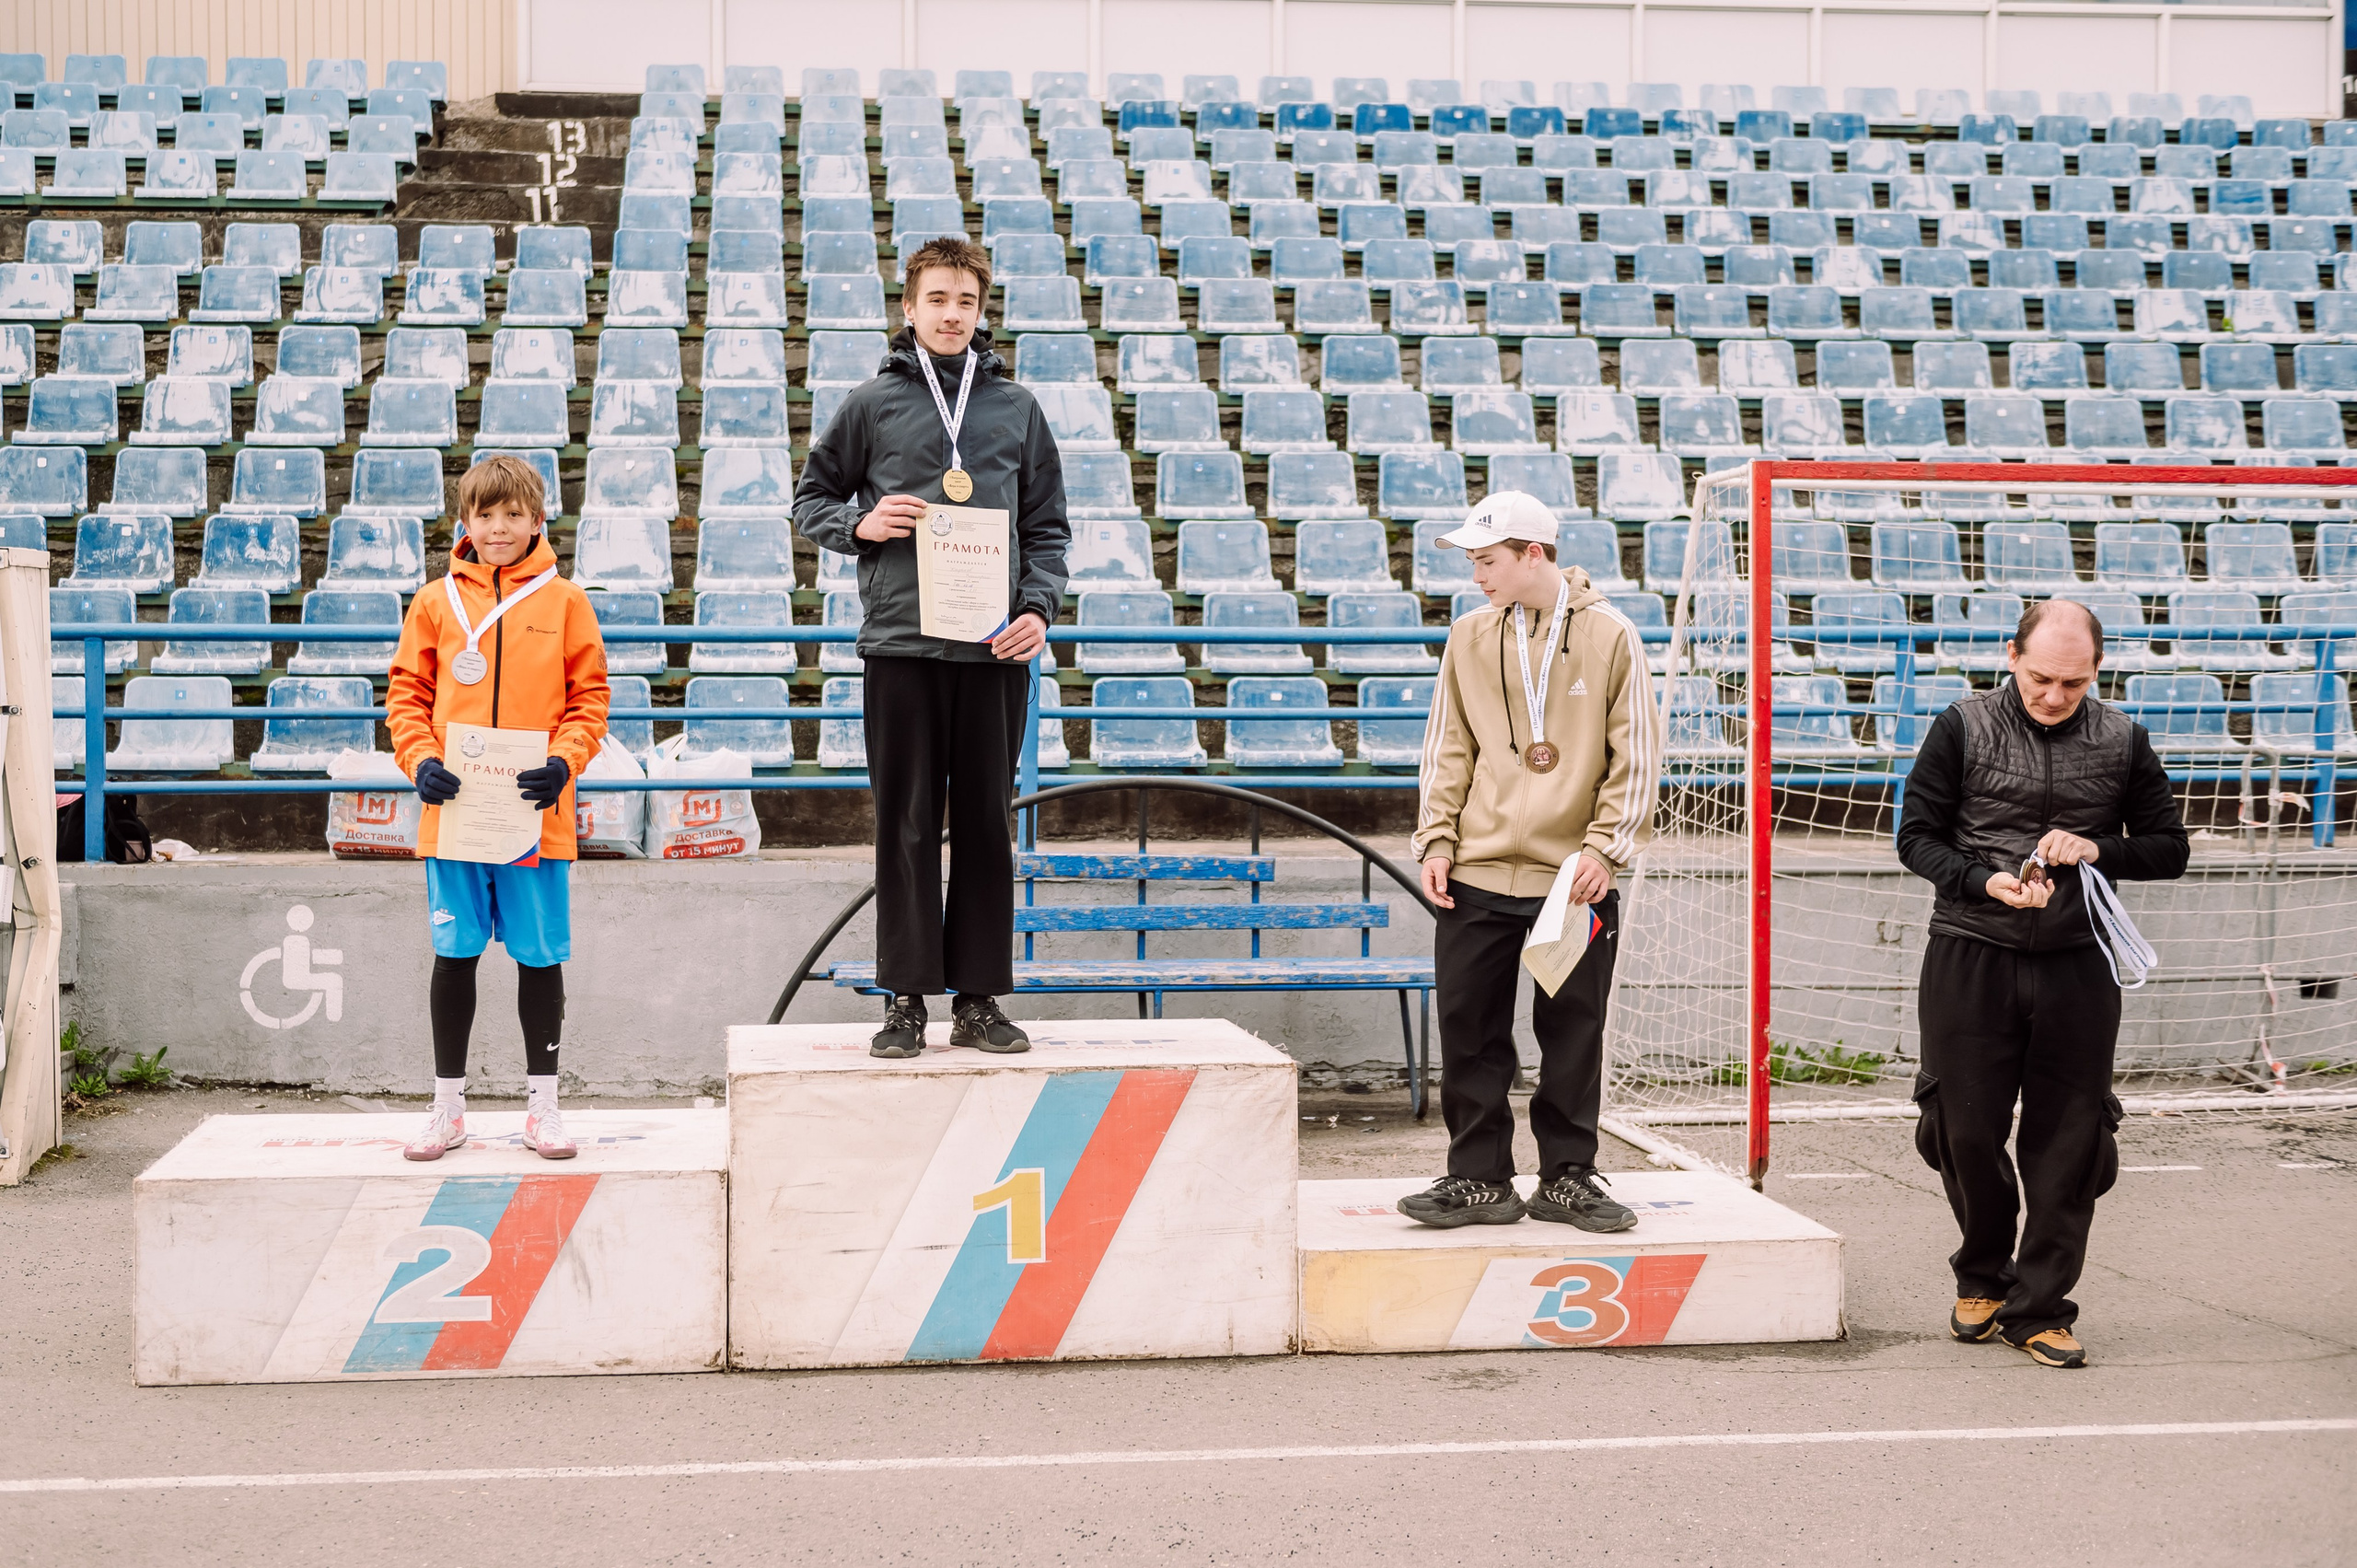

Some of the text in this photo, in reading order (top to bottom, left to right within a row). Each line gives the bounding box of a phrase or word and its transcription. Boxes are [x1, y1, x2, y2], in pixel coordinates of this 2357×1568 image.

[547, 121, 586, 154] 13
[536, 153, 578, 188] 12
[525, 186, 558, 222] 11
[934, 541, 1001, 555] ГРАМОТА
[463, 763, 528, 777] ГРАМО
[345, 830, 405, 842] Доставка
[671, 842, 739, 858] от 15 минут
[675, 829, 734, 843] Доставка
[973, 1167, 1046, 1264] 1
[373, 1225, 493, 1323] 2
[1527, 1260, 1630, 1344] 3
